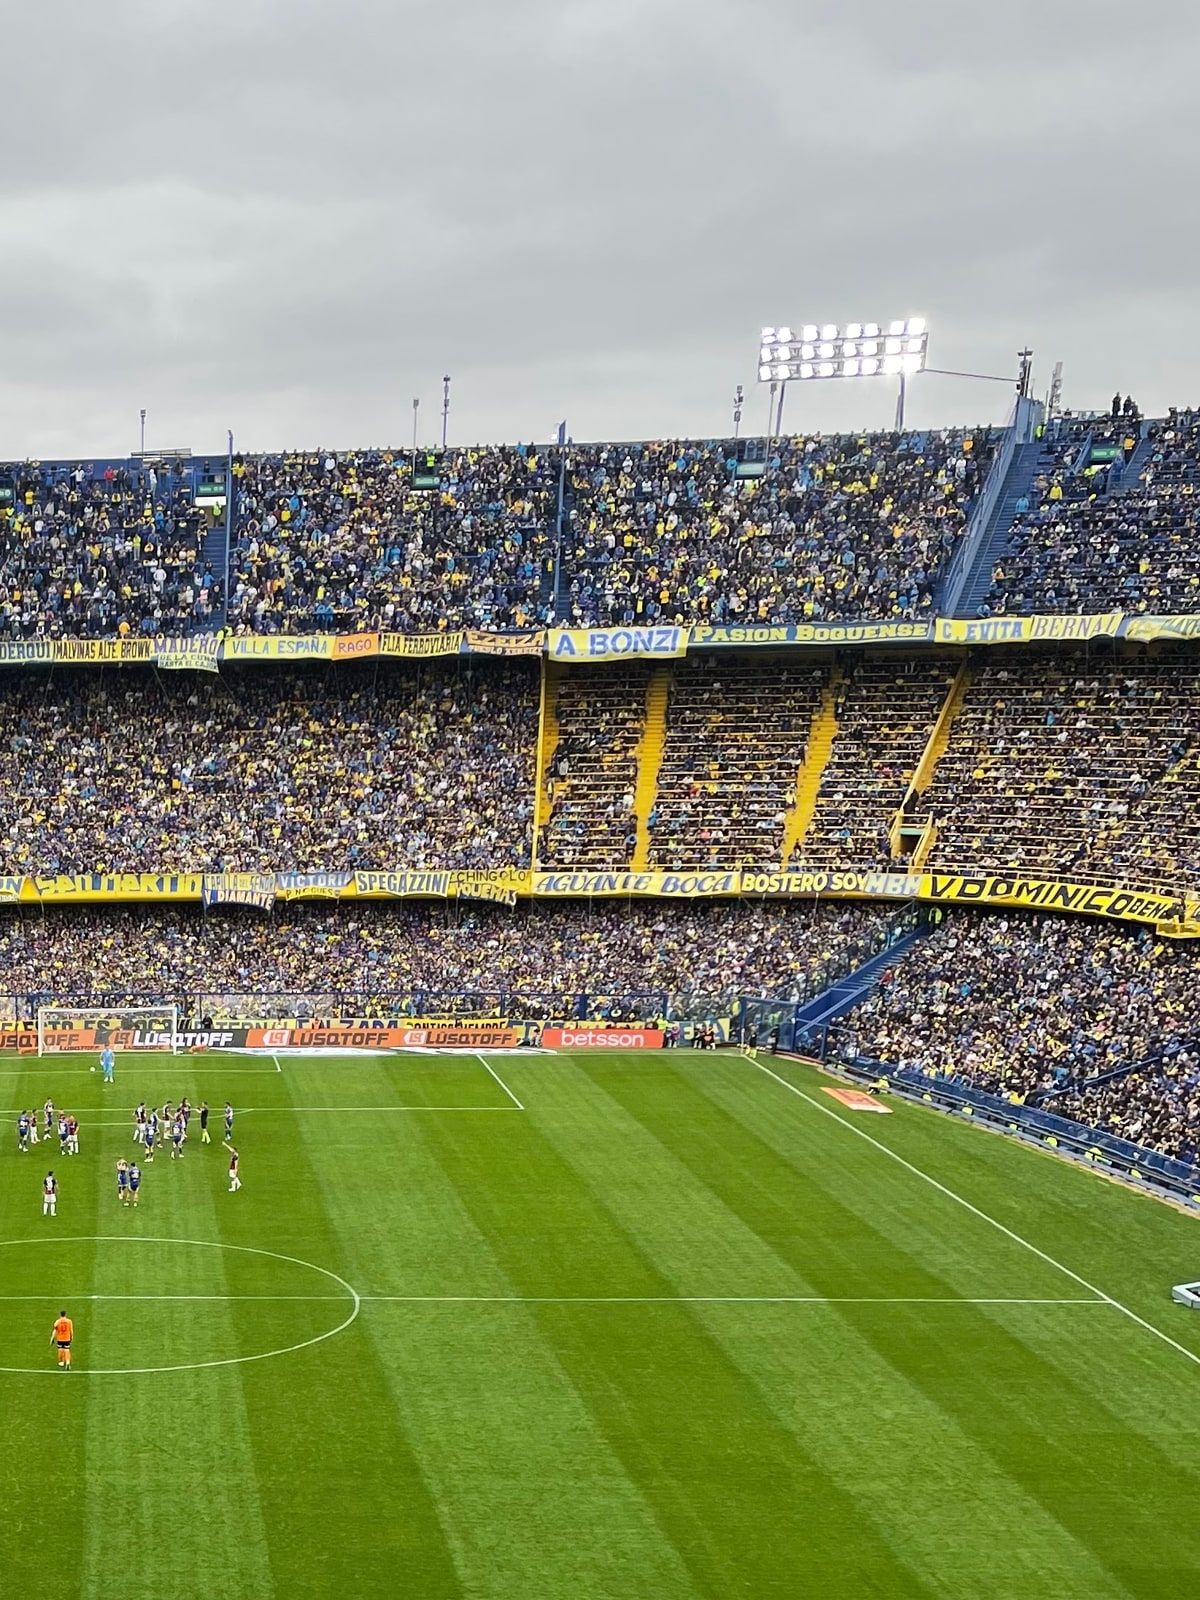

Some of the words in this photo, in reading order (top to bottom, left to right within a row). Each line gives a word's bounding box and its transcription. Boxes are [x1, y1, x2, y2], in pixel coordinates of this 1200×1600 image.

[966, 620, 1022, 641] EVITA
[1035, 615, 1116, 638] BERNAL
[1, 640, 51, 661] DERQUI
[55, 640, 96, 661] MALVINAS
[121, 638, 150, 659] BROWN
[154, 638, 219, 655] MADERO
[231, 638, 271, 655] VILLA
[277, 634, 328, 655] ESPAÑA
[338, 636, 373, 652] RAGO
[402, 632, 461, 654] FERROVIARIA
[588, 629, 680, 655] BONZI
[280, 873, 350, 888] VICTORIA
[357, 870, 448, 895] SPEGAZZINI
[535, 873, 652, 892] AGUANTE
[661, 874, 732, 893] BOCA
[741, 872, 823, 893] BOSTERO
[830, 872, 866, 891] SOY
[217, 890, 274, 908] DIAMANTE
[133, 1029, 234, 1047] LÜSQTOFF
[288, 1028, 390, 1047] LÜSQTOFF
[425, 1029, 513, 1046] LÜSQTOFF
[561, 1030, 645, 1048] betsson
